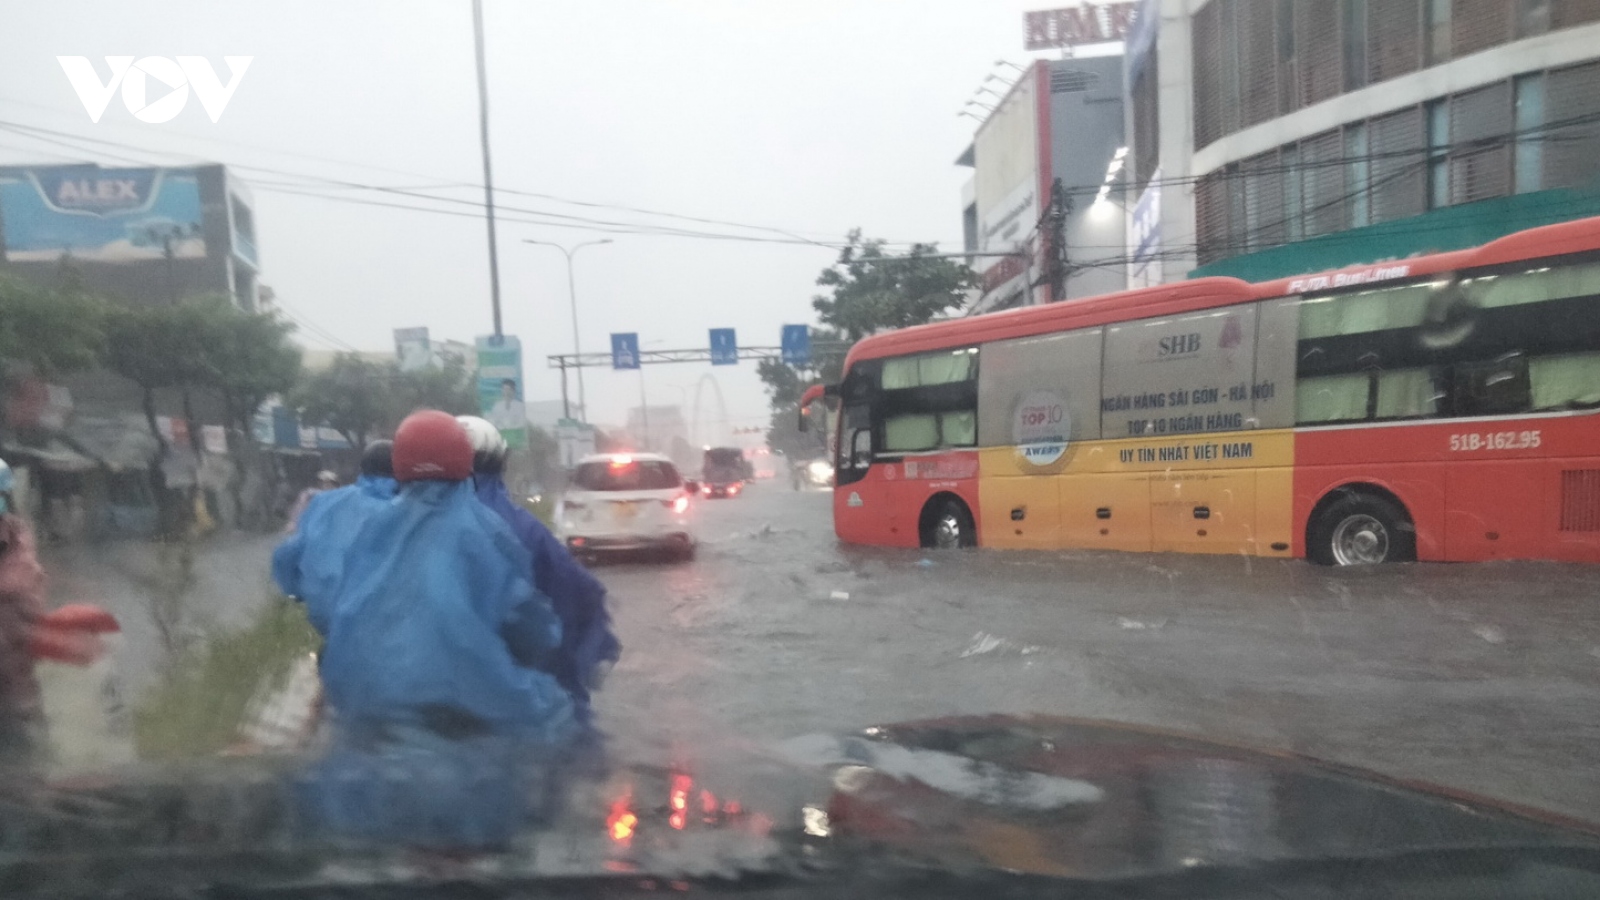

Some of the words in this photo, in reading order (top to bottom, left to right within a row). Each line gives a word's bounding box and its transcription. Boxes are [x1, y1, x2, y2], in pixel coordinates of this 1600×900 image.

[58, 178, 139, 203] ALEX
[1288, 275, 1330, 294] FUTA
[1159, 333, 1201, 356] SHB
[1102, 393, 1131, 412] NGÂN
[1134, 391, 1165, 409] HÀNG
[1229, 382, 1247, 401] HÀ
[1251, 379, 1275, 401] NỘI
[1022, 412, 1046, 426] TOP
[1047, 404, 1063, 424] 10
[1127, 419, 1148, 434] TOP
[1153, 417, 1166, 432] 10
[1169, 413, 1203, 432] NGÂN
[1207, 411, 1242, 430] HÀNG
[1120, 448, 1133, 463] UY
[1138, 444, 1155, 462] TÍN
[1159, 440, 1190, 462] NHẤT
[1193, 441, 1219, 462] VIỆT
[1222, 442, 1253, 459] NAM
[1450, 430, 1542, 451] 51B-162.95
